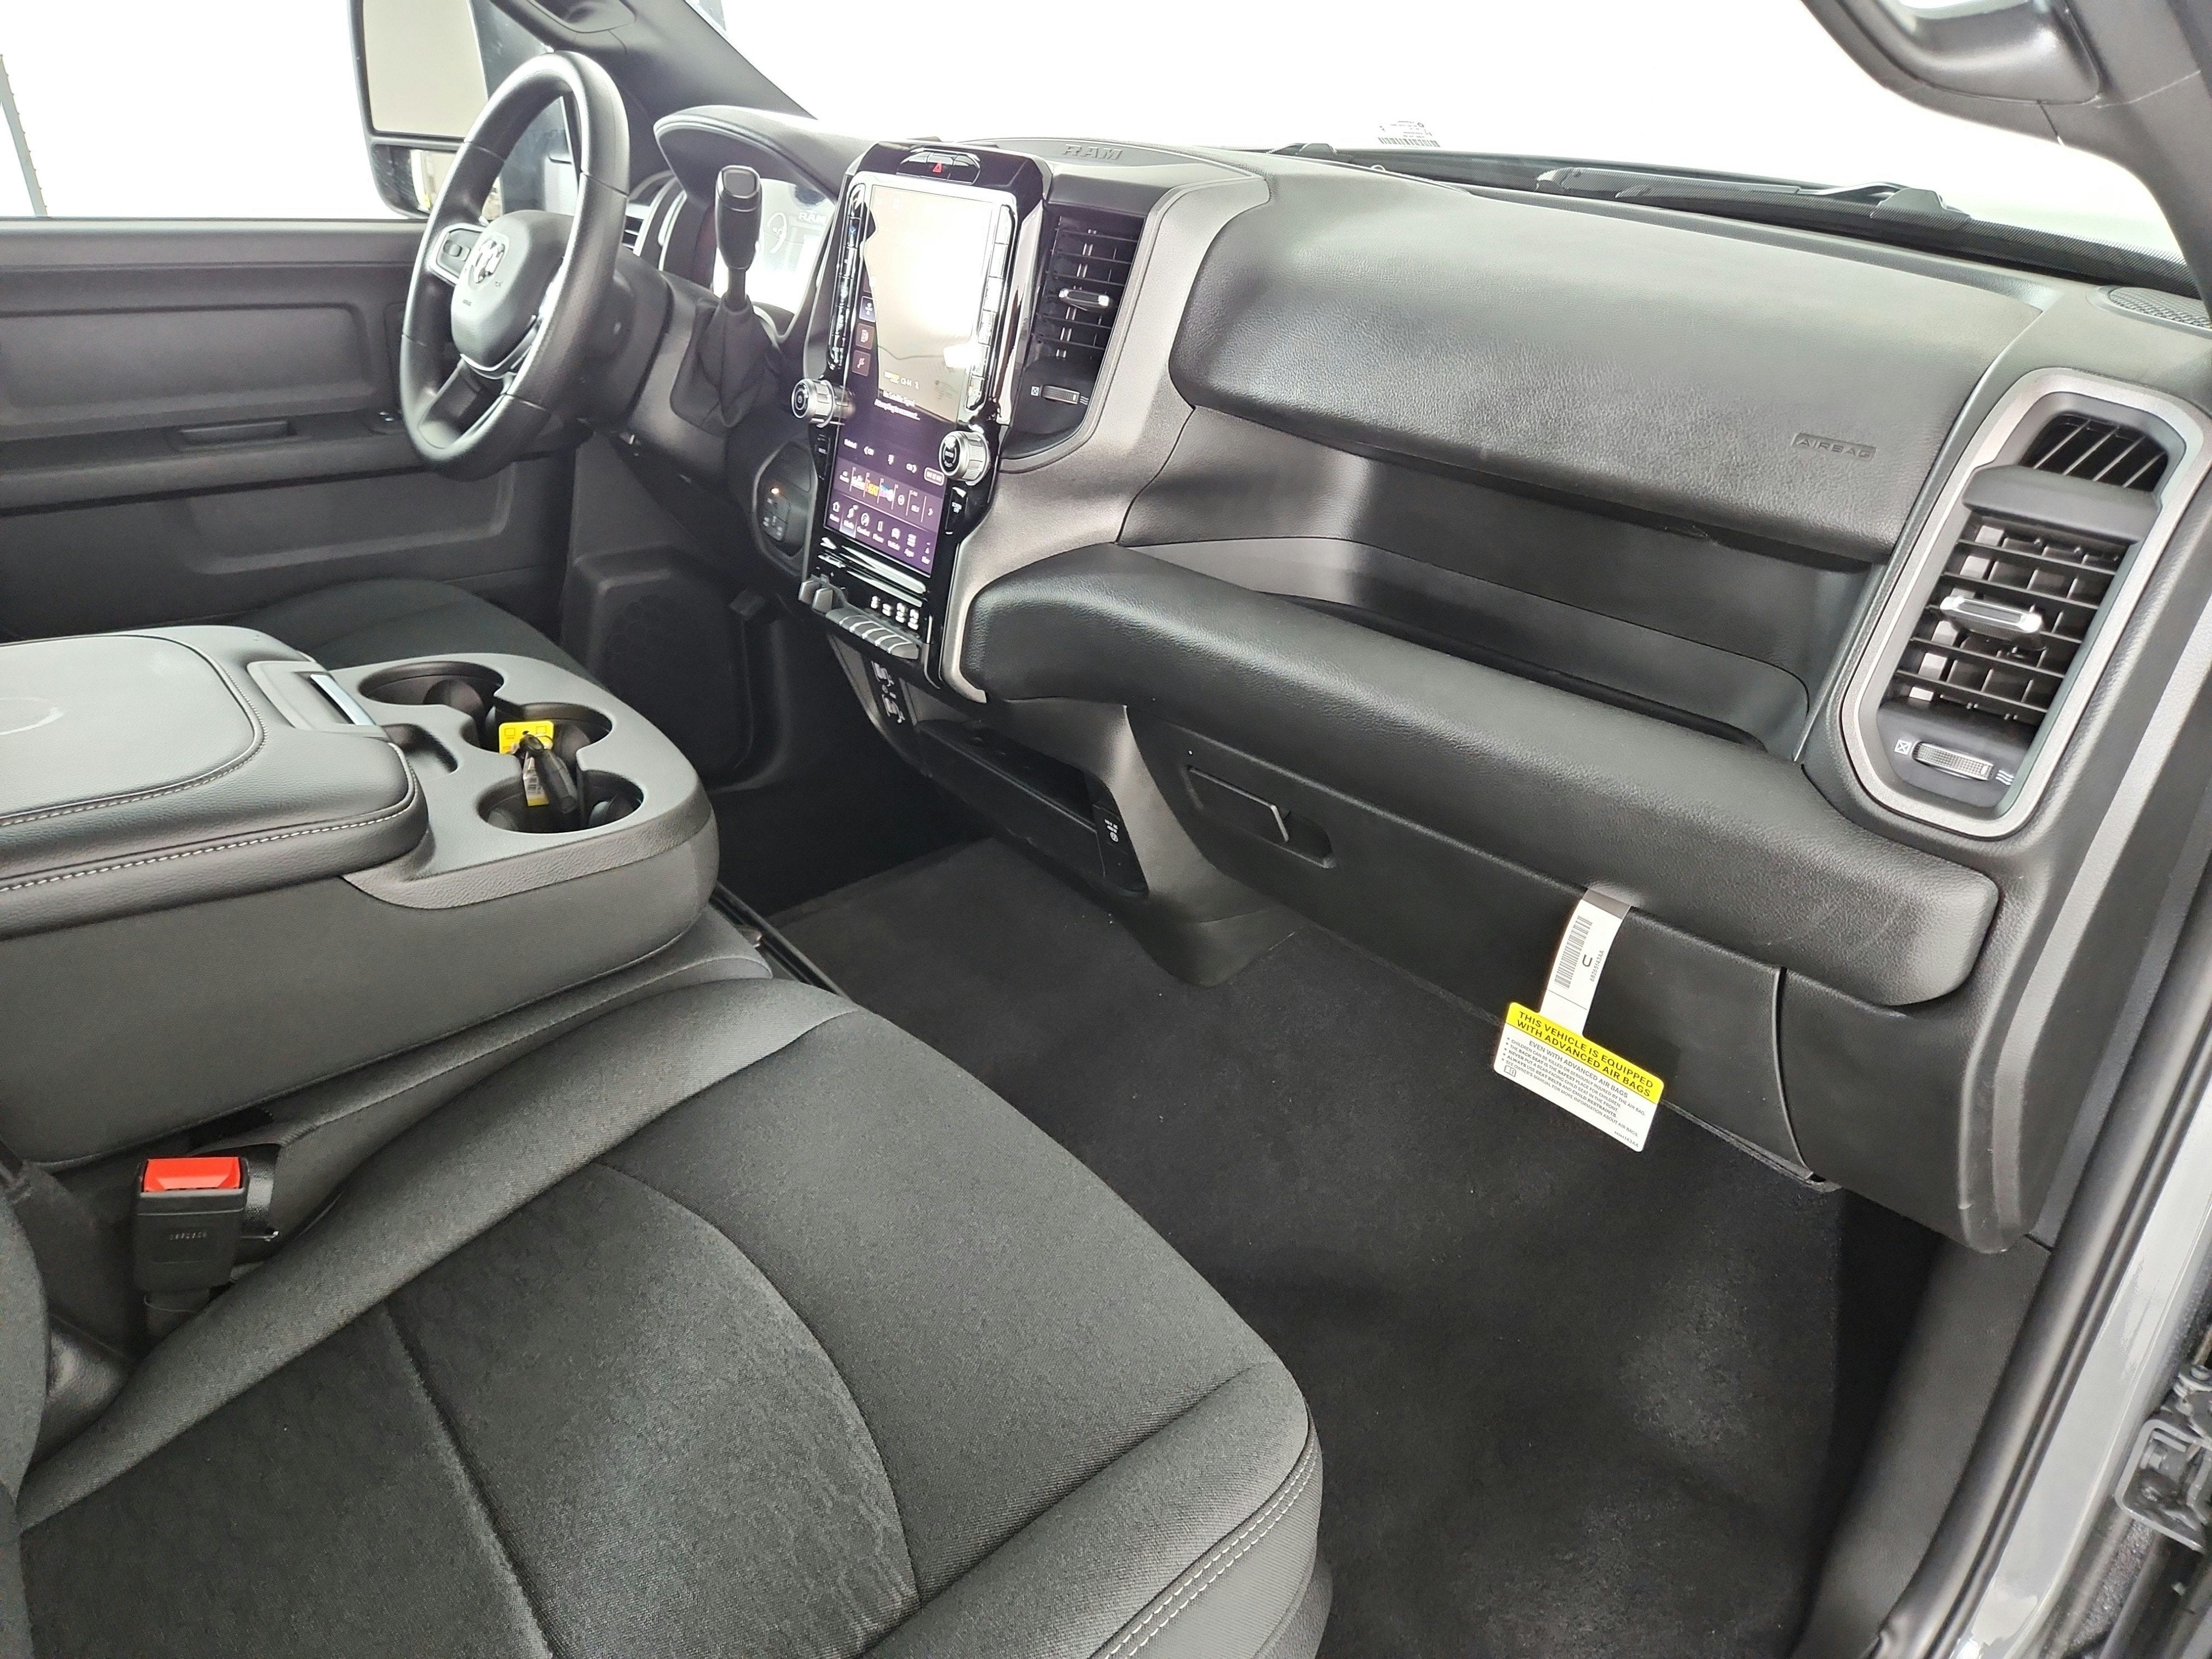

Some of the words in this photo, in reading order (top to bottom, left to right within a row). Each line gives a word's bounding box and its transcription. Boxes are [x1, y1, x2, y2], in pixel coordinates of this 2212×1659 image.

[1061, 143, 1123, 160] RAM
[1796, 437, 1871, 459] AIRBAG
[1582, 954, 1593, 967] U
[1506, 1055, 1527, 1068] ALWAYS
[1526, 1064, 1536, 1073] USE
[1547, 1076, 1562, 1087] BELTS
[1510, 1043, 1519, 1052] THE
[1518, 1048, 1532, 1058] BACK
[1549, 1064, 1558, 1073] THE
[1557, 1069, 1576, 1082] SAFEST
[1575, 1079, 1589, 1090] PLACE
[1589, 1086, 1599, 1095] FOR
[1511, 1039, 1532, 1053] CHILDREN
[1548, 1058, 1563, 1069] KILLED
[1593, 1083, 1612, 1096] INJURED
[1618, 1097, 1628, 1105] THE
[1517, 1019, 1543, 1038] WITH
[1544, 1035, 1600, 1068] ADVANCED
[1602, 1066, 1620, 1080] AIR
[1622, 1076, 1651, 1097] BAGS
[1519, 1011, 1542, 1028] THIS
[1544, 1023, 1587, 1052] VEHICLE
[1588, 1047, 1599, 1058] IS
[1600, 1054, 1653, 1088] EQUIPPED
[1528, 1040, 1545, 1053] EVEN
[1546, 1049, 1563, 1062] WITH
[1563, 1059, 1598, 1081] ADVANCED
[1598, 1078, 1610, 1088] AIR
[1610, 1084, 1628, 1098] BAGS
[1508, 1049, 1525, 1060] NEVER
[1594, 1096, 1603, 1104] THE
[1533, 1074, 1551, 1087] MANUAL
[1560, 1089, 1573, 1099] MORE
[1573, 1096, 1603, 1116] INFORMATION
[1602, 1113, 1618, 1125] ABOUT
